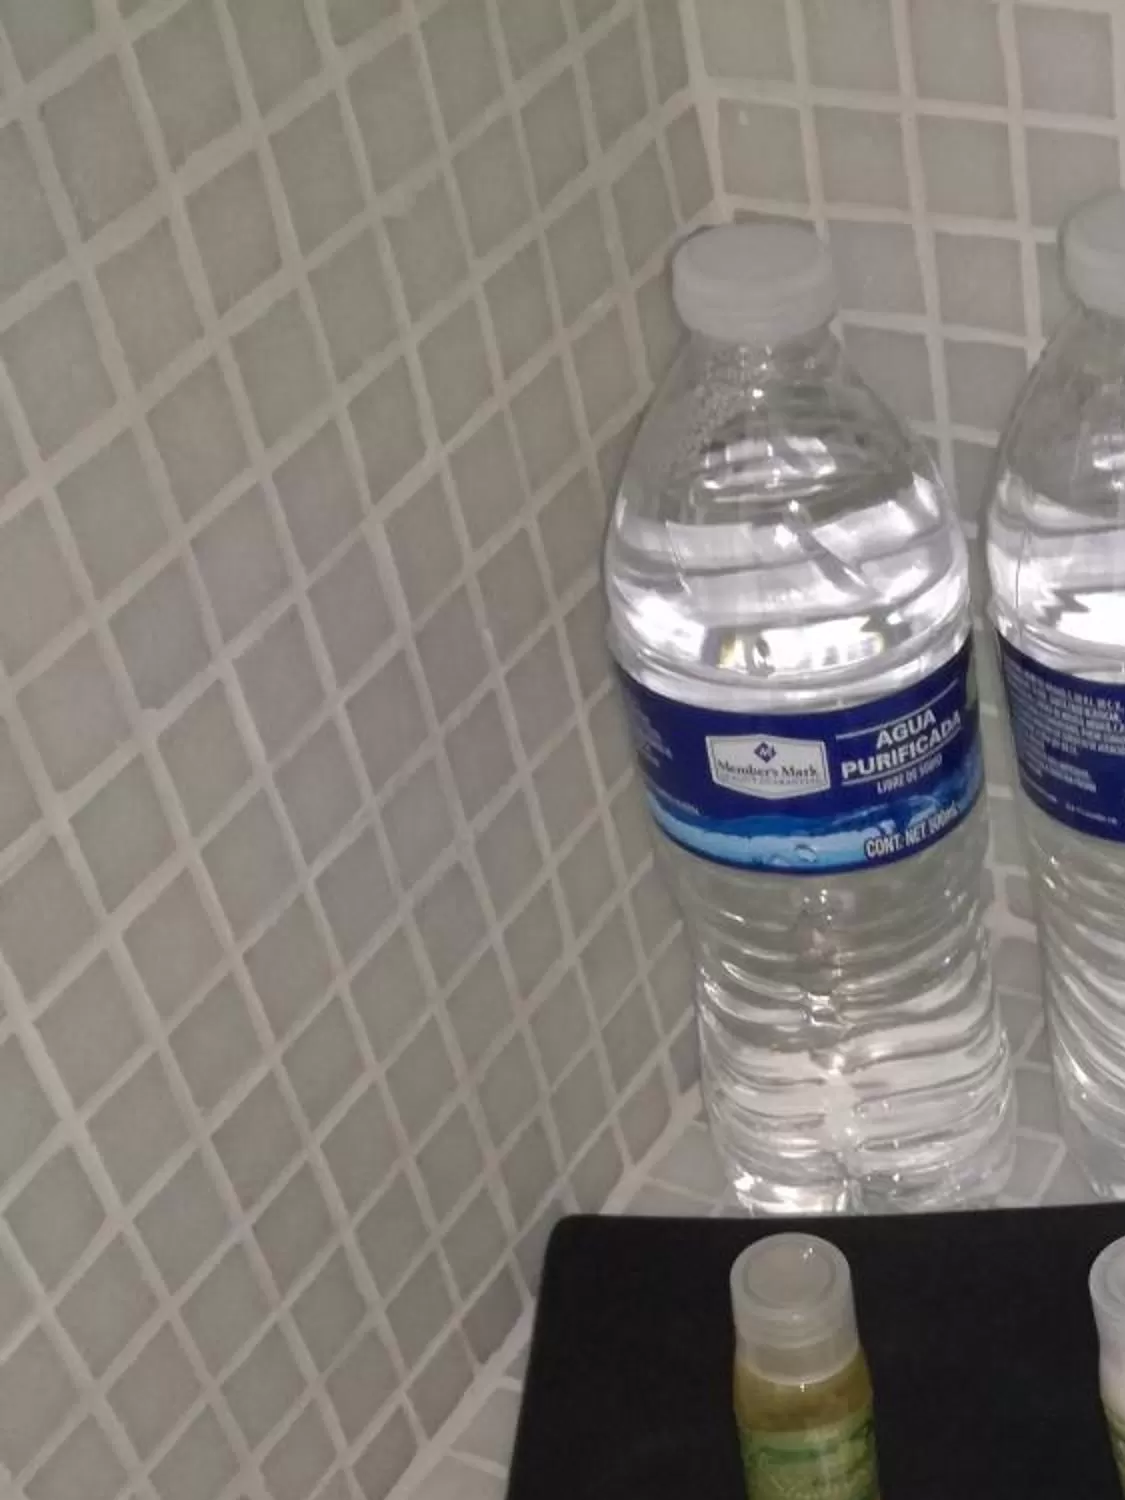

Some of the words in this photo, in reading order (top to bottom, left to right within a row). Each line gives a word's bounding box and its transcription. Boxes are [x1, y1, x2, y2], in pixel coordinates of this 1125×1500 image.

[841, 710, 961, 779] PURIFICADA
[876, 708, 936, 749] AGUA
[781, 764, 817, 777] Mark
